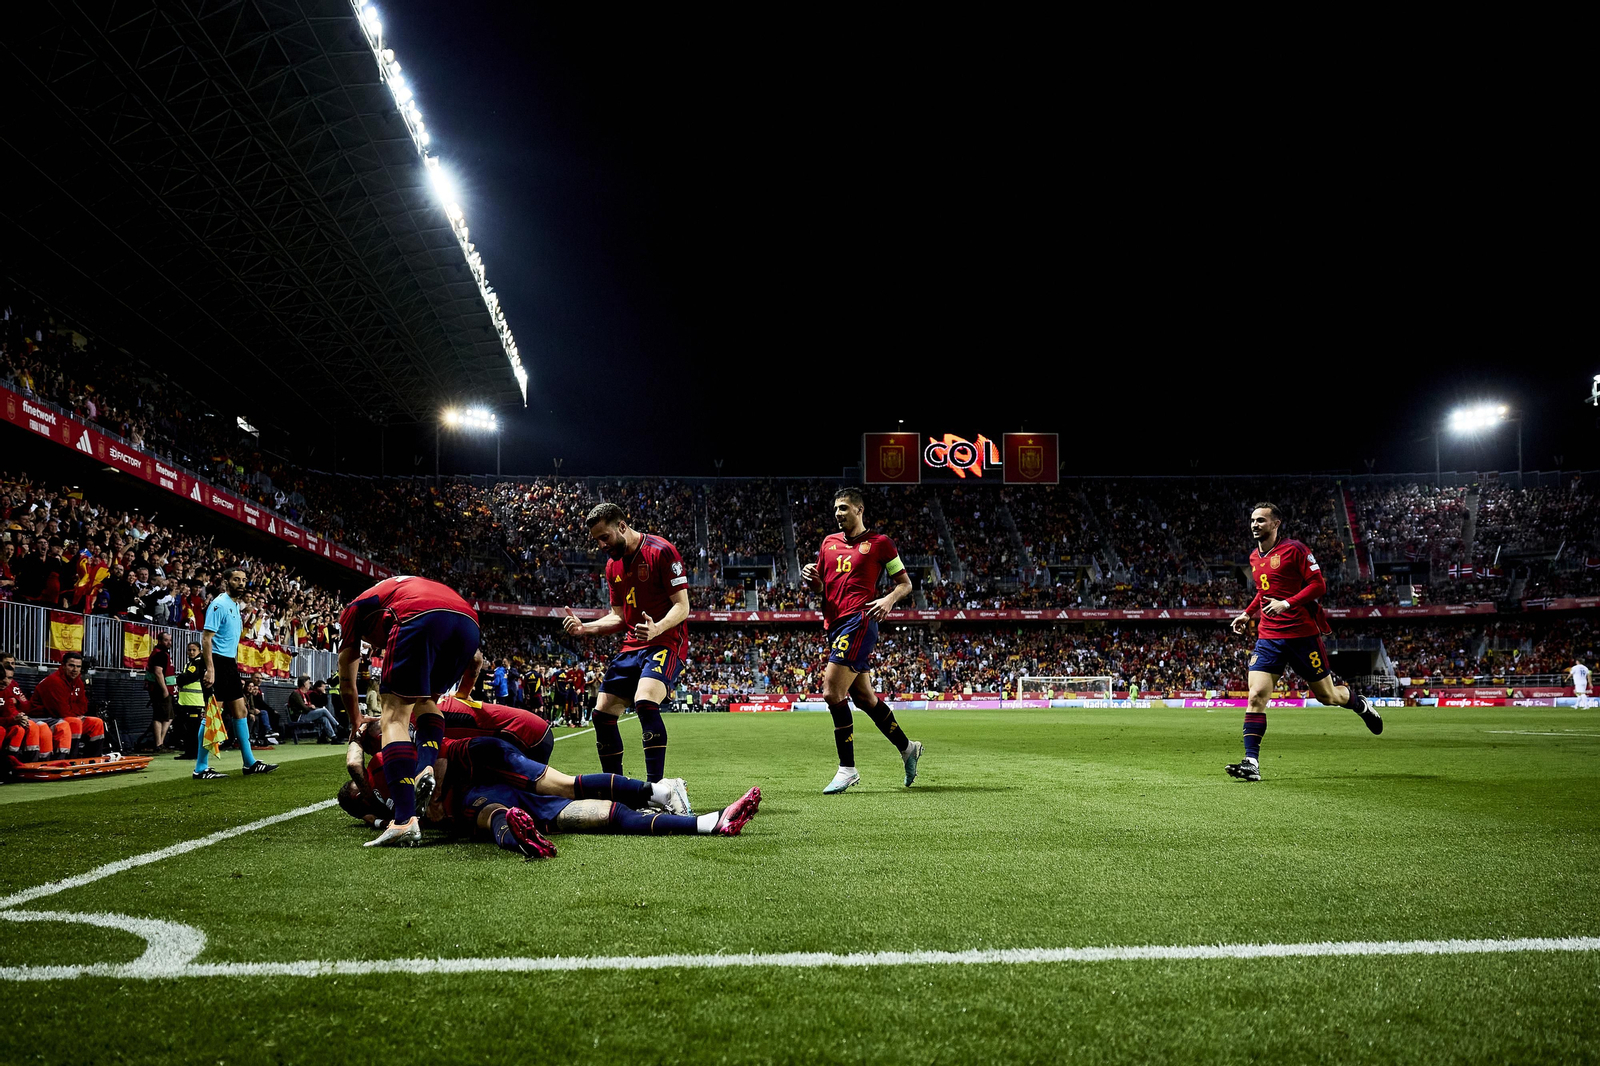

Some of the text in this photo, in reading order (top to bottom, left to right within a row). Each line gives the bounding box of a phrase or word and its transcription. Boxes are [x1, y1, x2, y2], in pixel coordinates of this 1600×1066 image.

[22, 400, 57, 425] finetwork
[924, 439, 1003, 470] GOL
[155, 462, 178, 481] finetwork
[835, 554, 852, 573] 16
[1259, 573, 1270, 591] 8
[625, 586, 637, 608] 4
[831, 633, 850, 651] 16
[652, 648, 668, 667] 4
[1308, 650, 1322, 669] 8
[740, 702, 763, 713] renfe
[945, 701, 968, 710] renfe
[1083, 700, 1108, 708] Nadie
[1121, 700, 1132, 708] da
[1192, 700, 1215, 708] renfe
[1375, 699, 1385, 707] da
[1388, 699, 1405, 707] más
[1445, 698, 1472, 708] renfe
